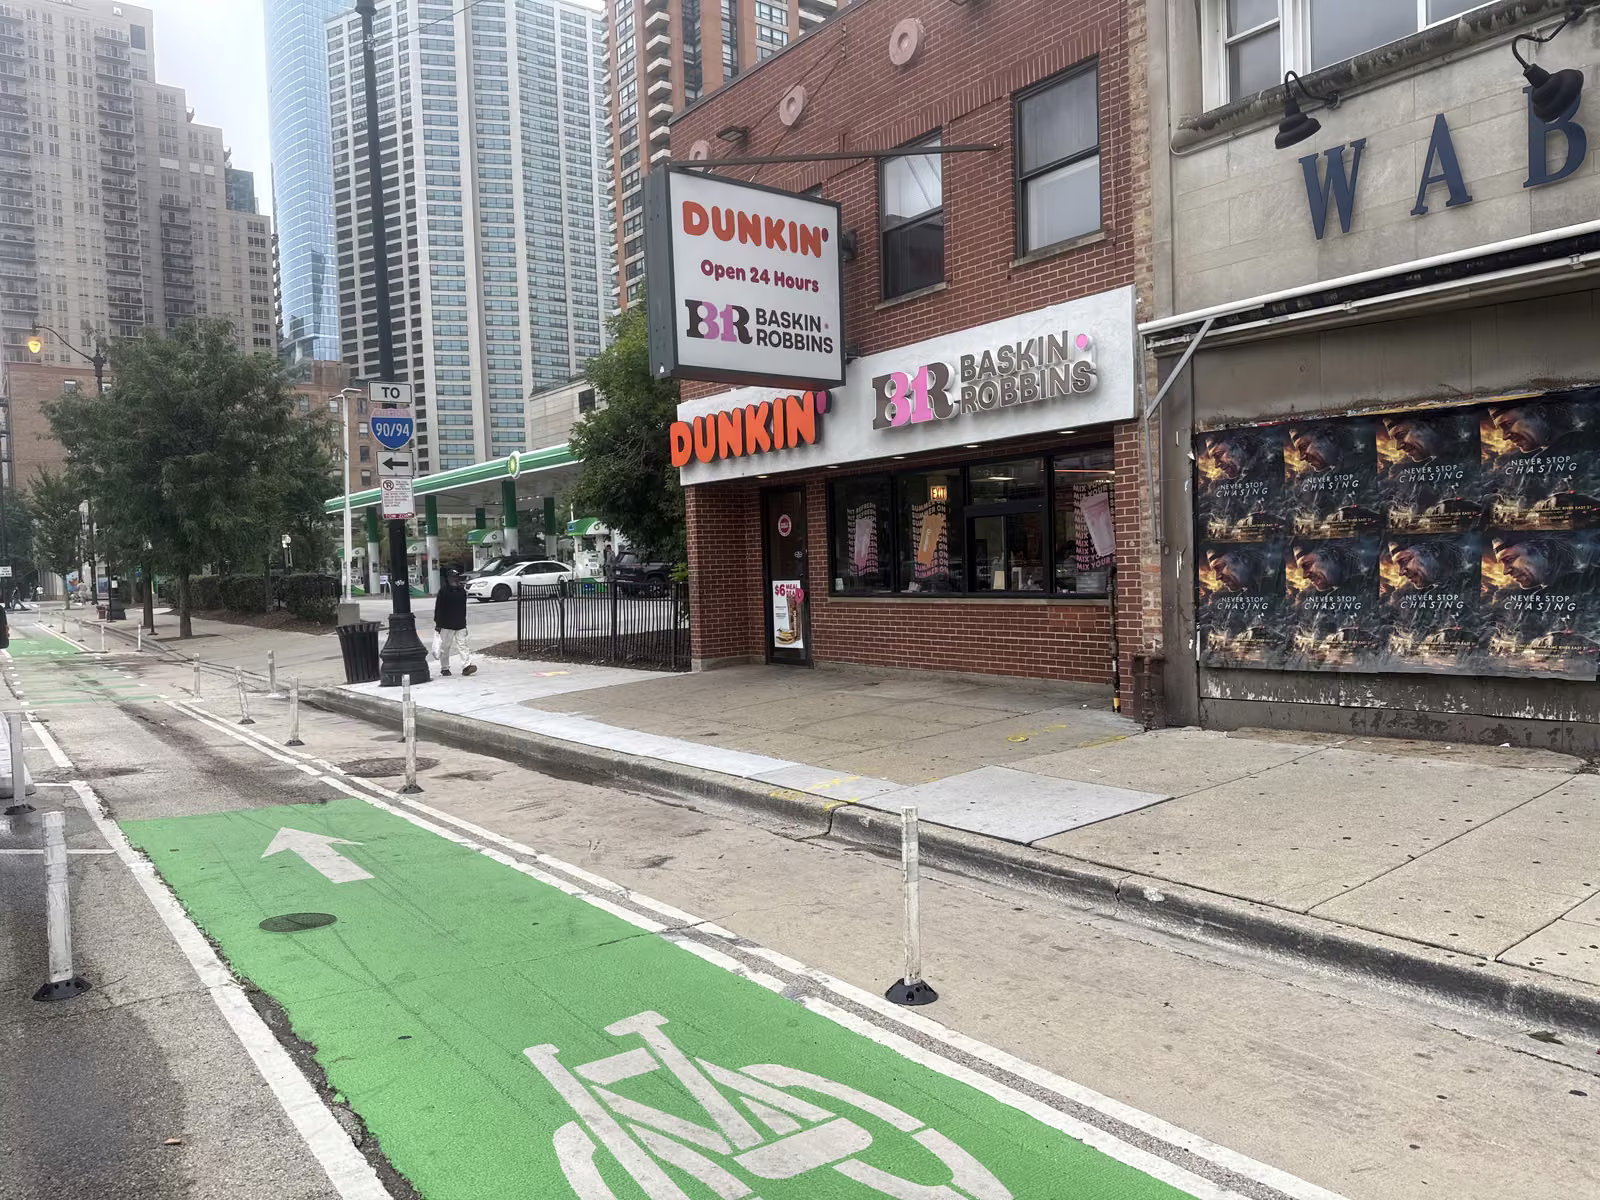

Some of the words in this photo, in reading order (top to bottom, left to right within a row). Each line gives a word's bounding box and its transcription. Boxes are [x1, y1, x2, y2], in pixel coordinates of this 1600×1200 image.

[682, 200, 829, 259] DUNKIN'
[701, 259, 746, 282] Open
[750, 267, 770, 285] 24
[774, 270, 819, 293] Hours
[755, 308, 821, 333] BASKIN
[756, 328, 834, 354] ROBBINS
[960, 330, 1069, 383] BASKIN
[381, 387, 400, 399] TO
[960, 360, 1093, 414] ROBBINS
[375, 422, 410, 437] 90/94
[669, 390, 829, 468] DUNKIN'
[1511, 457, 1542, 467] NEVER
[1546, 456, 1571, 464] STOP
[1404, 466, 1432, 474] NEVER
[1436, 464, 1458, 472] STOP
[1505, 462, 1577, 475] CHASING
[1307, 476, 1331, 484] NEVER
[1399, 471, 1464, 483] CHASING
[1302, 480, 1359, 491] CHASING
[1216, 487, 1268, 498] CHASING
[775, 583, 786, 597] $6
[1400, 601, 1464, 609] CHASING
[1545, 595, 1570, 603] STOP
[1304, 602, 1362, 610] CHASING
[1504, 601, 1577, 611] CHASING
